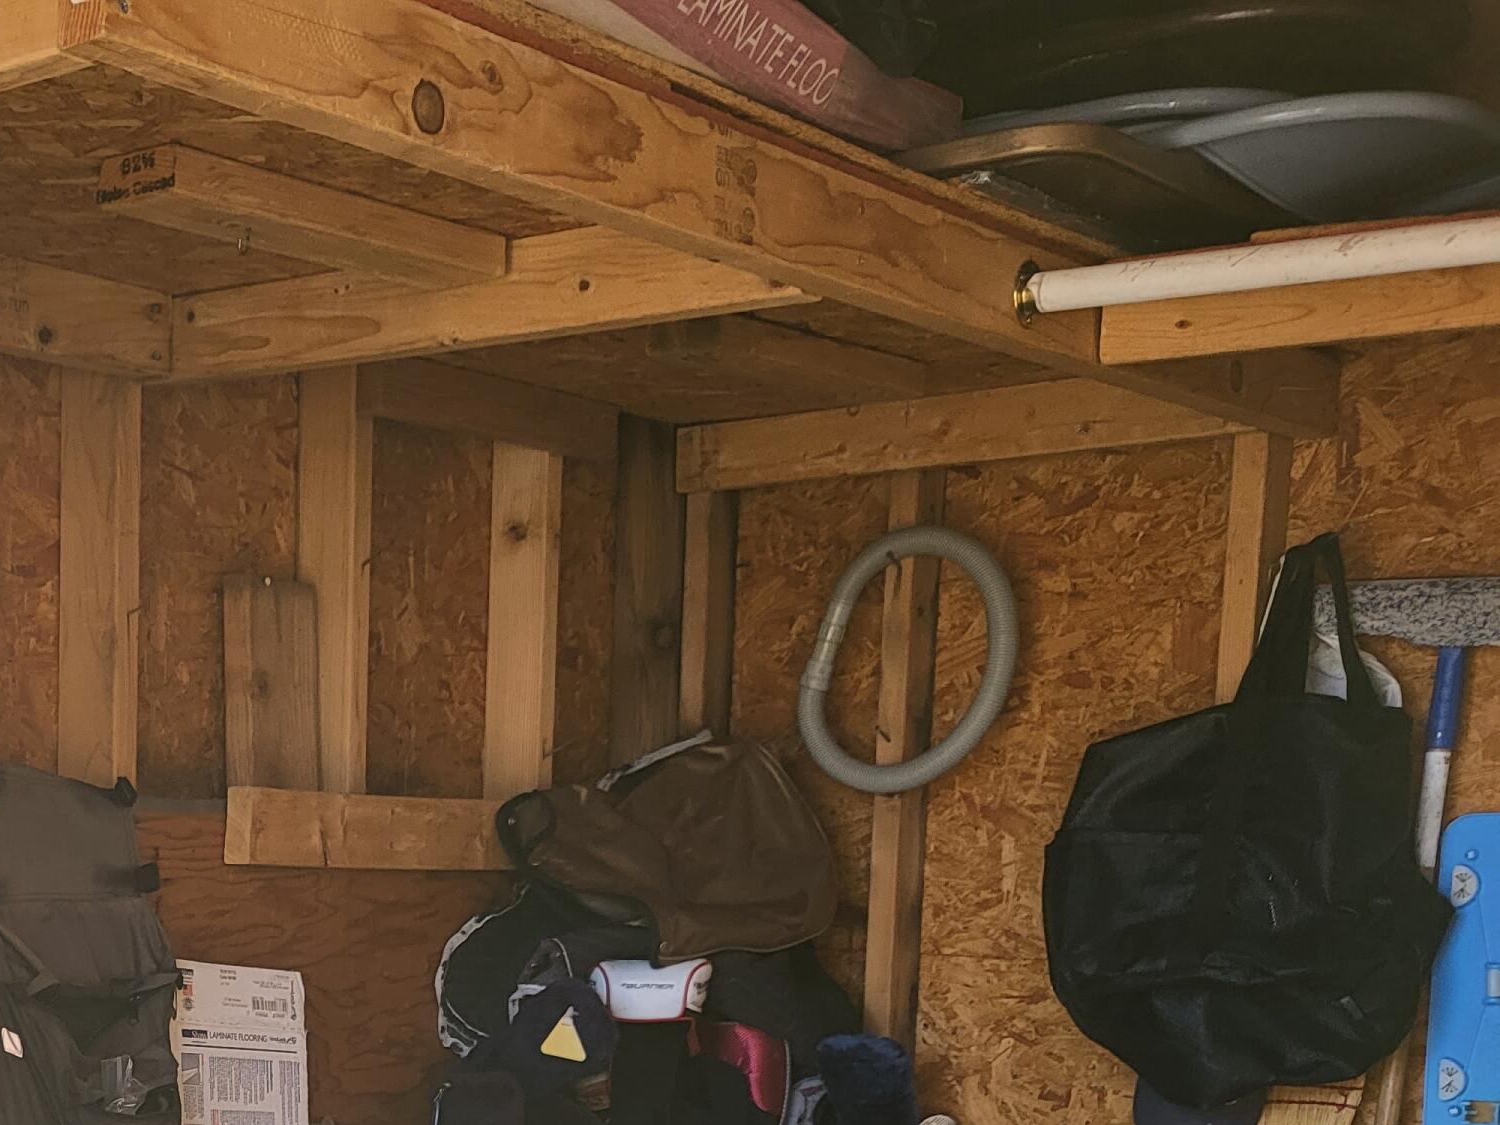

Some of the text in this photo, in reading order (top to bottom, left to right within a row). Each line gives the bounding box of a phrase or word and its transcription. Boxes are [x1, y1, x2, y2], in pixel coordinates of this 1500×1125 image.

[778, 42, 840, 110] FLOO
[208, 1031, 238, 1042] LAMINATE
[238, 1032, 268, 1043] FLOORING
